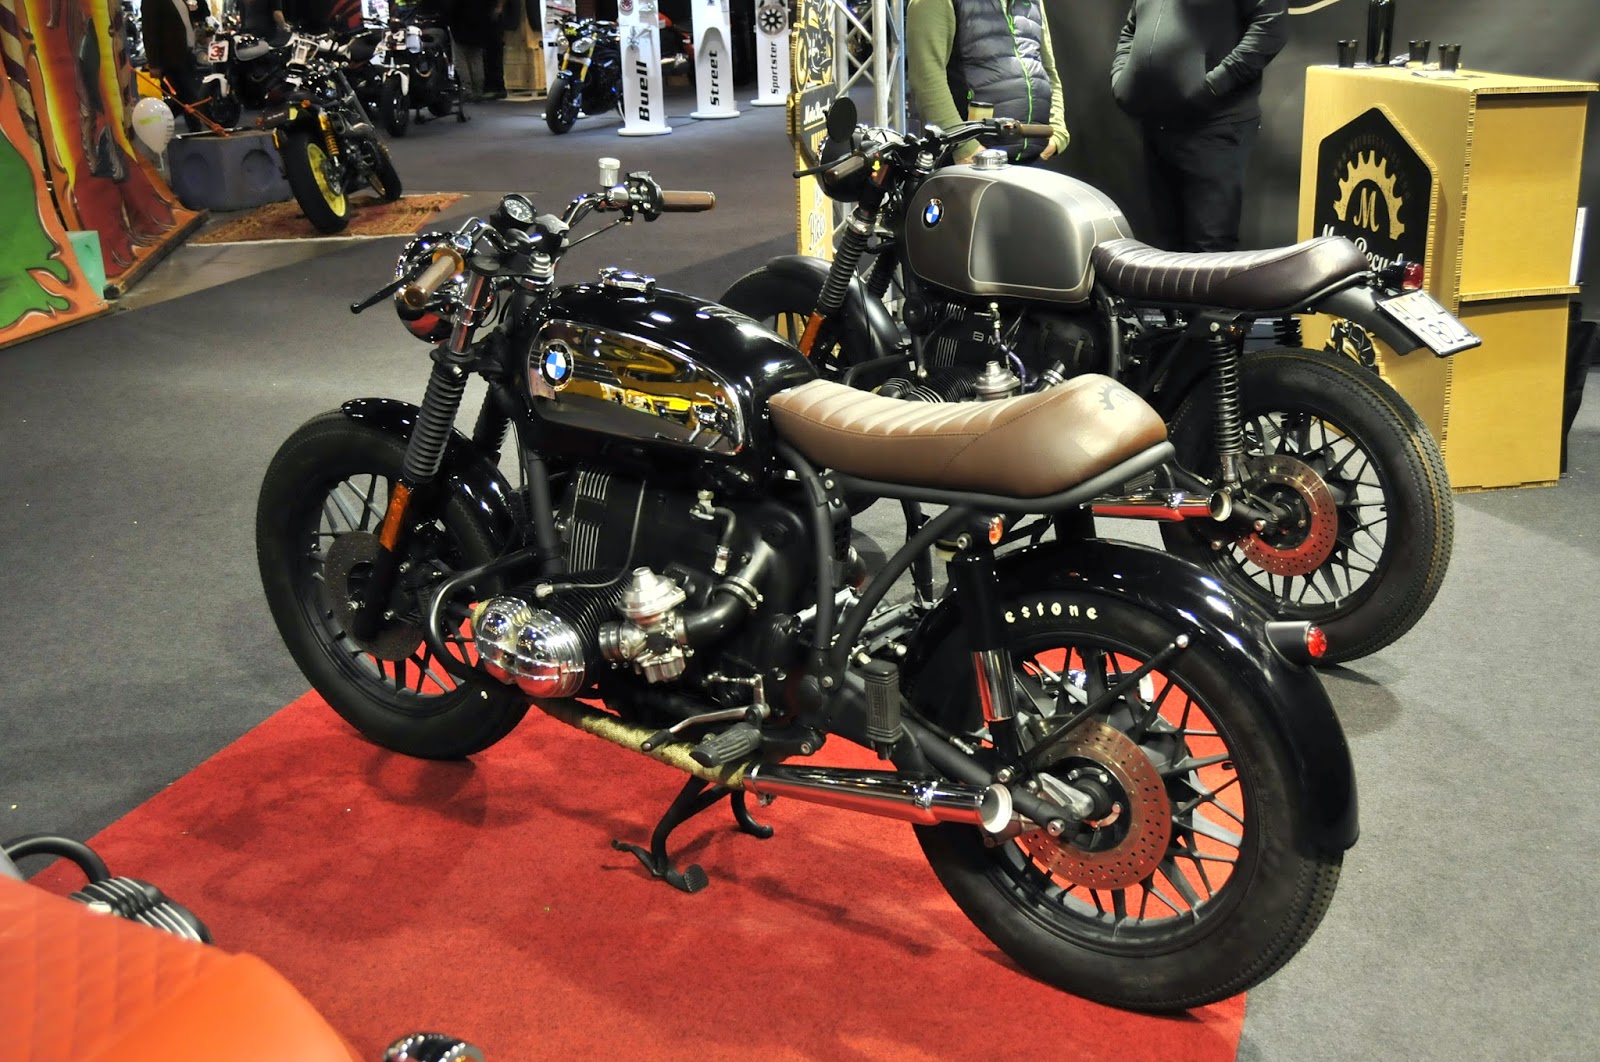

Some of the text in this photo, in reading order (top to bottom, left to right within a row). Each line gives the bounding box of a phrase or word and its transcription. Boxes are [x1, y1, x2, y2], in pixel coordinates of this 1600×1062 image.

[636, 60, 650, 122] Buell
[709, 50, 720, 106] Street
[771, 41, 779, 94] Sportster
[1353, 187, 1379, 232] M
